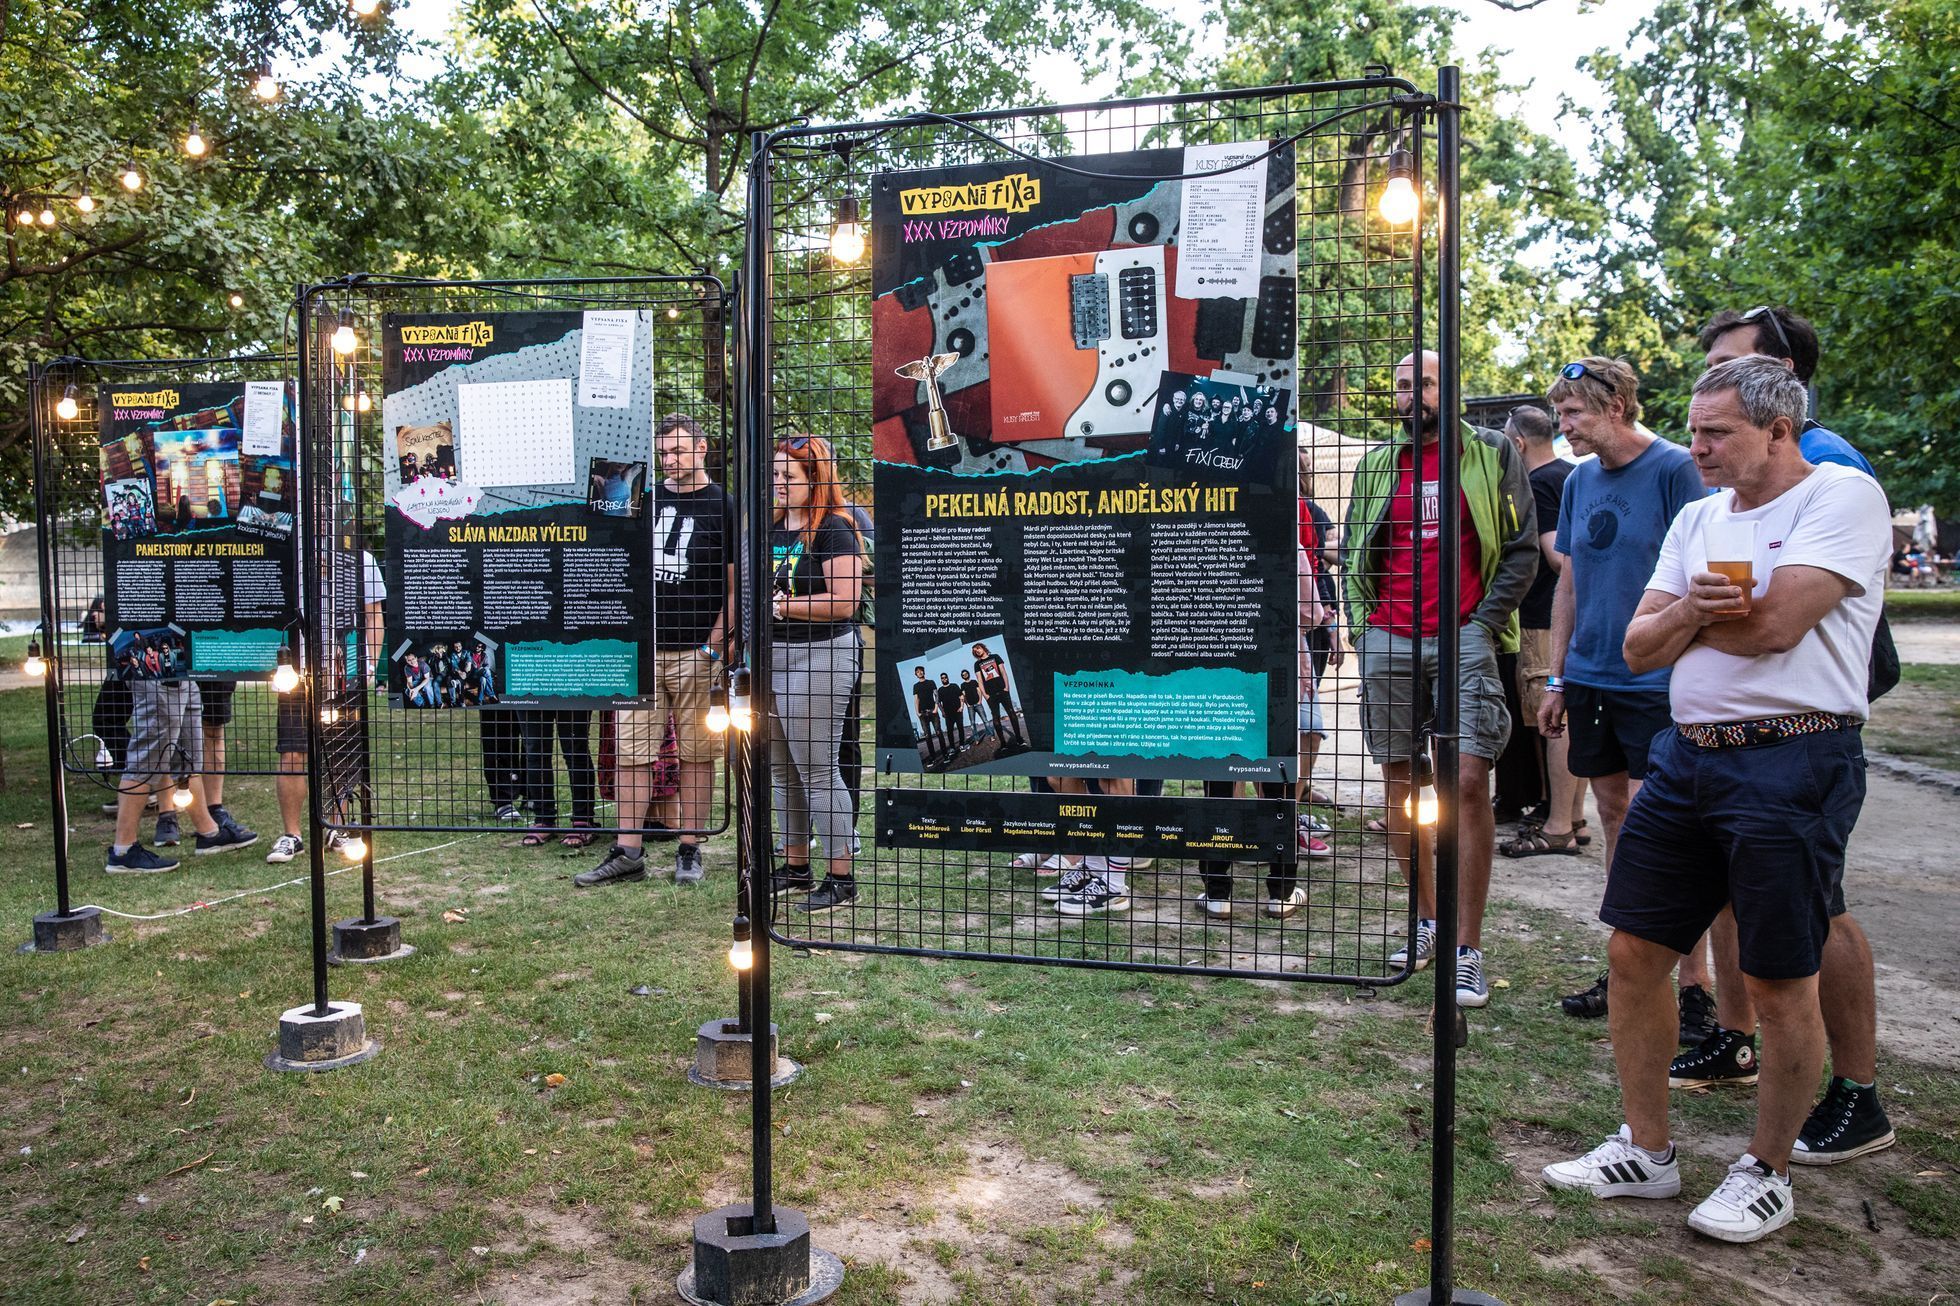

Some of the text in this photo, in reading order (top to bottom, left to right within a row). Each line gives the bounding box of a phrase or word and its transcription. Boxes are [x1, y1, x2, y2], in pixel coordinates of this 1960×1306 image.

[1196, 160, 1220, 170] KUSY
[904, 220, 935, 243] XXX
[403, 347, 425, 362] XXX
[114, 408, 130, 420] XXX
[926, 482, 1239, 518] PEKELNÁ RADOST, ANDĚLSKÝ HIT
[1422, 496, 1439, 520] IXA
[913, 527, 929, 535] napsal
[958, 526, 970, 534] Kusy
[1050, 524, 1083, 532] procházkách
[1085, 523, 1112, 532] prázdným
[1177, 522, 1196, 530] později
[1226, 521, 1245, 529] kapela
[449, 522, 587, 542] SLÁVA NAZDAR VÝLETU
[136, 544, 264, 556] PANELSTORY JE V DETAILECH
[1090, 547, 1104, 555] objev
[1151, 546, 1172, 555] vytvořil
[1024, 556, 1038, 564] scény
[953, 588, 970, 596] Ondřej
[1059, 805, 1097, 817] KREDITY
